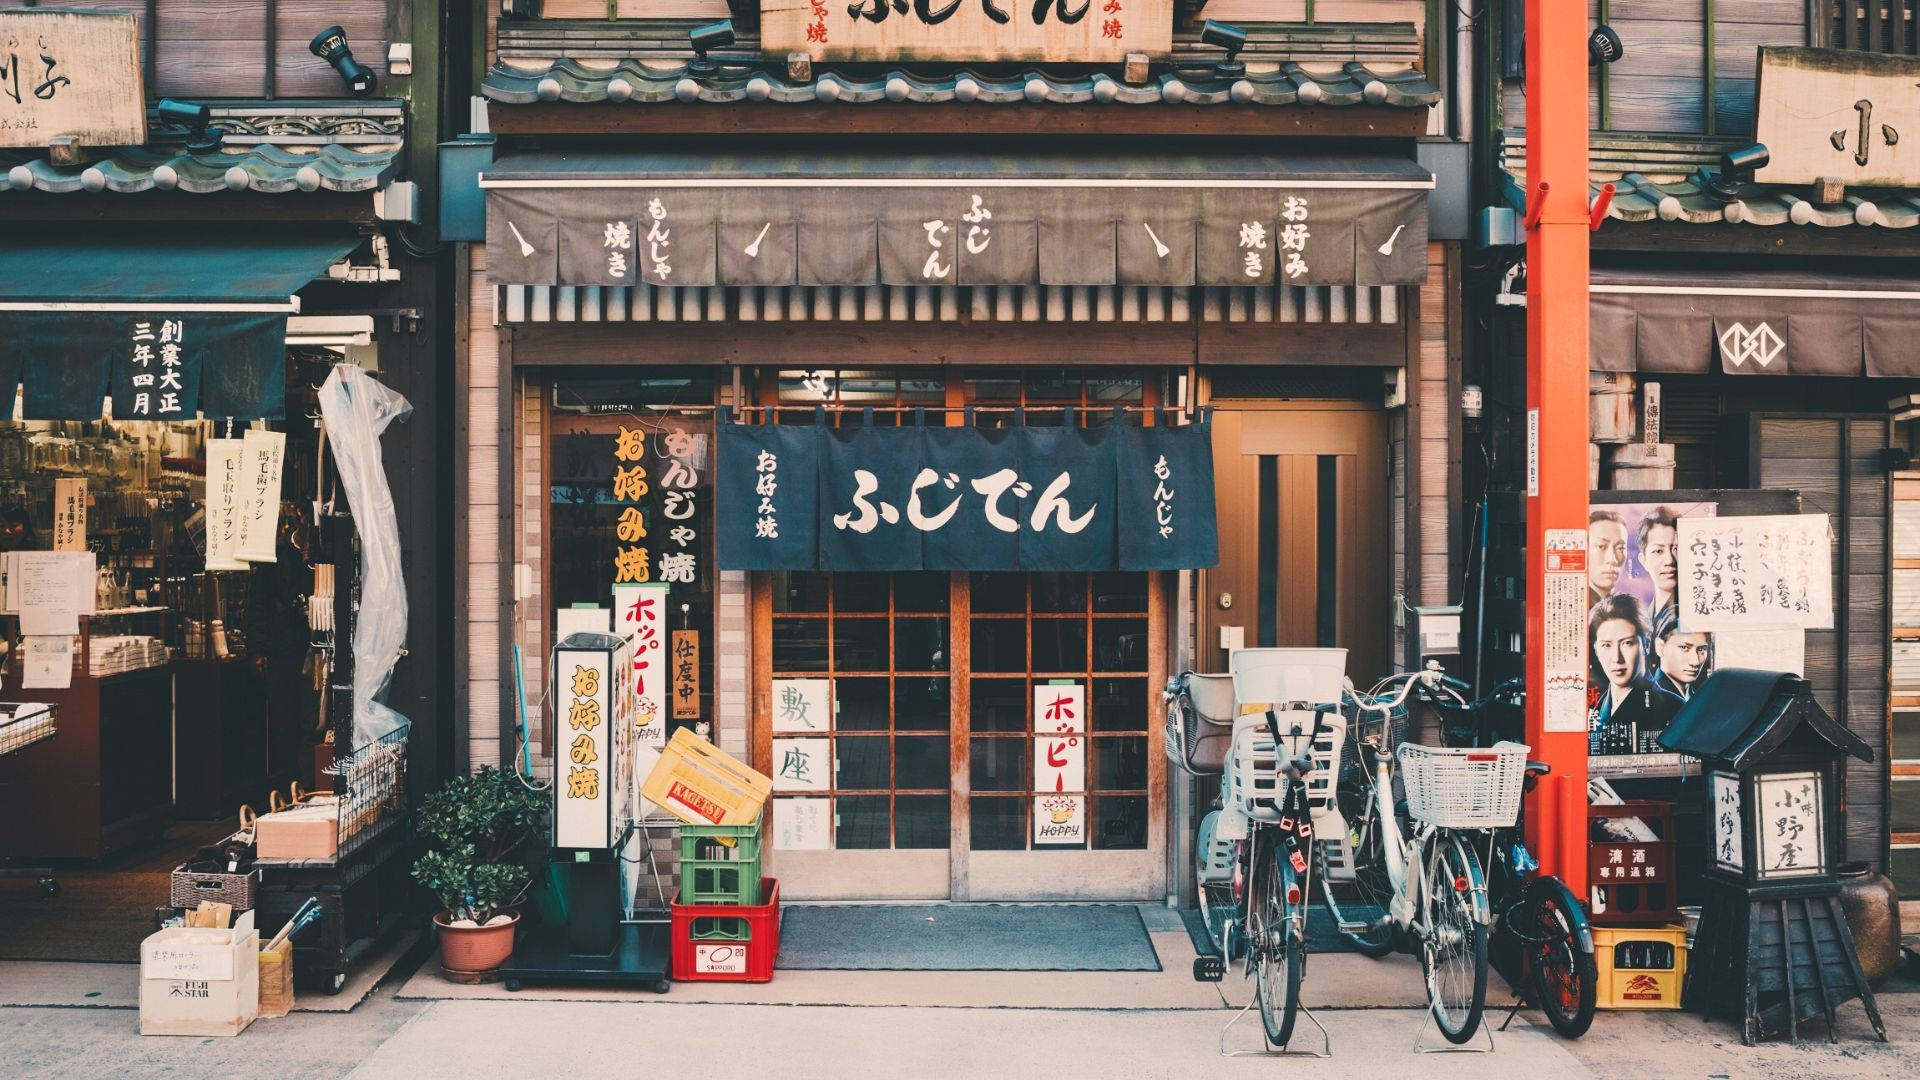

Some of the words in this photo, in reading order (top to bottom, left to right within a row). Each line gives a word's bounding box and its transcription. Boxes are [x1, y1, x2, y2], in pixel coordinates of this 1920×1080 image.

[1829, 98, 1899, 167] 小
[604, 221, 631, 278] 焼き
[647, 198, 672, 280] もんじゃ
[922, 217, 951, 279] でん
[963, 194, 992, 255] ふじ
[1239, 222, 1267, 279] 焼き
[1282, 195, 1311, 280] お好み
[133, 322, 155, 415] 三年四月
[159, 319, 183, 414] 創業大正
[613, 424, 650, 584] お好み焼
[658, 427, 698, 583] もんじゃ焼
[755, 449, 779, 539] お好み焼
[833, 468, 1097, 534] ふじでん
[1153, 454, 1174, 540] もんじゃ
[675, 638, 696, 703] 仕度中
[568, 664, 600, 800] お好み焼
[1045, 691, 1078, 793] ホッピー
[1608, 848, 1646, 864] 清酒
[1721, 786, 1734, 861] 小野屋
[1775, 789, 1804, 868] 小野屋
[185, 981, 208, 990] FUJI
[735, 948, 744, 957] 20
[185, 990, 209, 998] STAR
